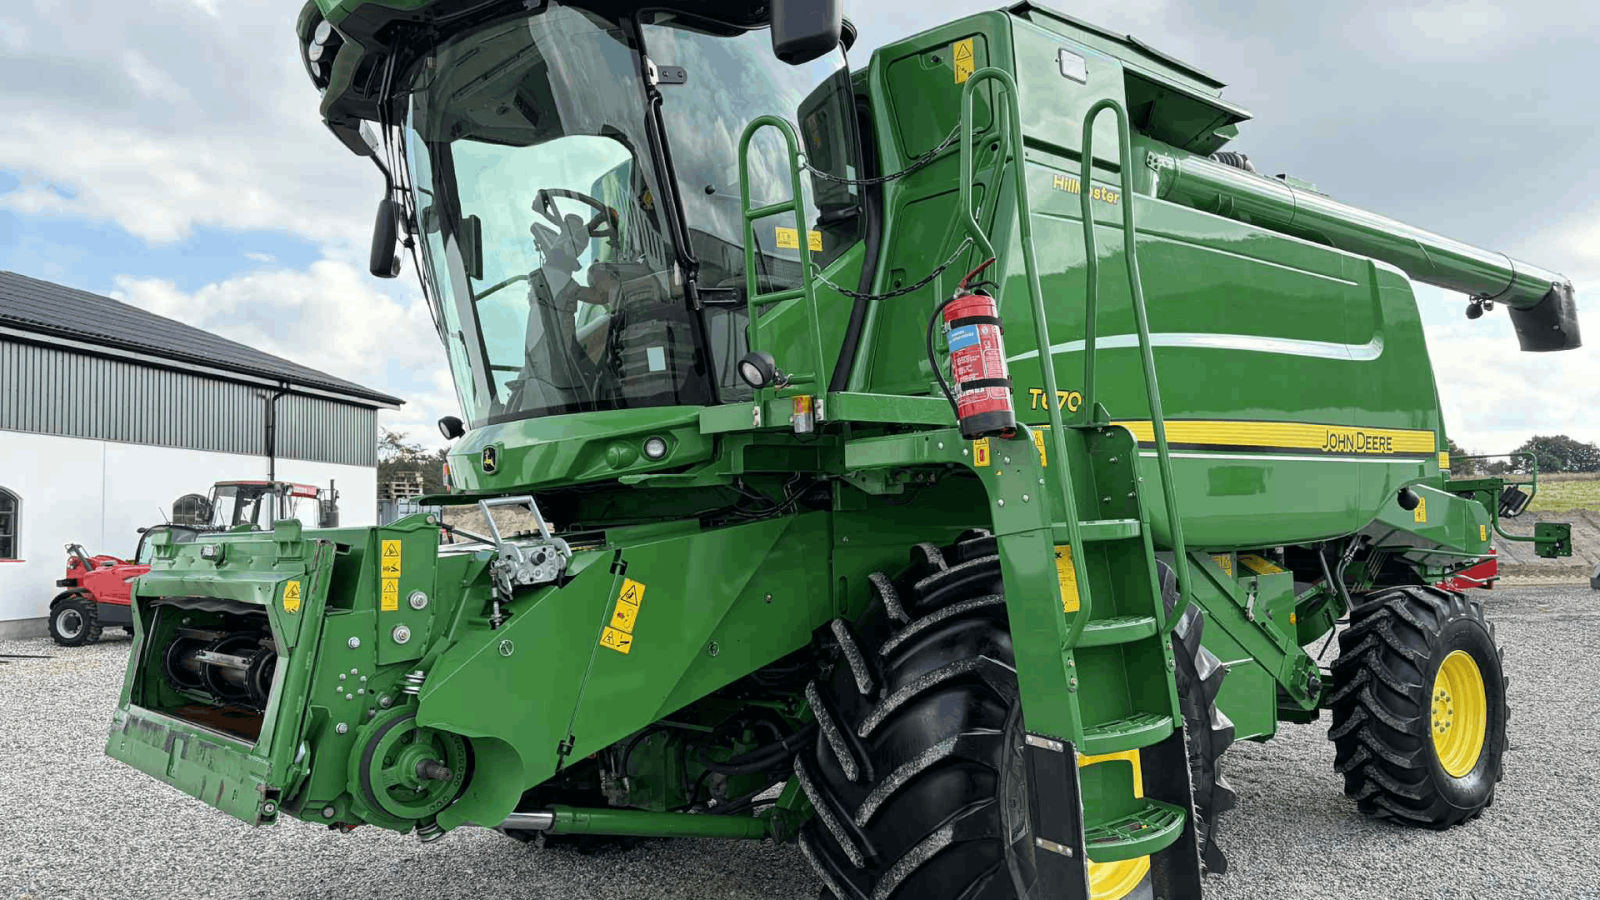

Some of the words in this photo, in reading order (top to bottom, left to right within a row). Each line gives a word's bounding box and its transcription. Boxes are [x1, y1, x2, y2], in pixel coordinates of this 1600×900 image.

[1053, 174, 1120, 204] Hillster
[1322, 429, 1354, 449] JOHN
[1356, 431, 1393, 451] DEERE
